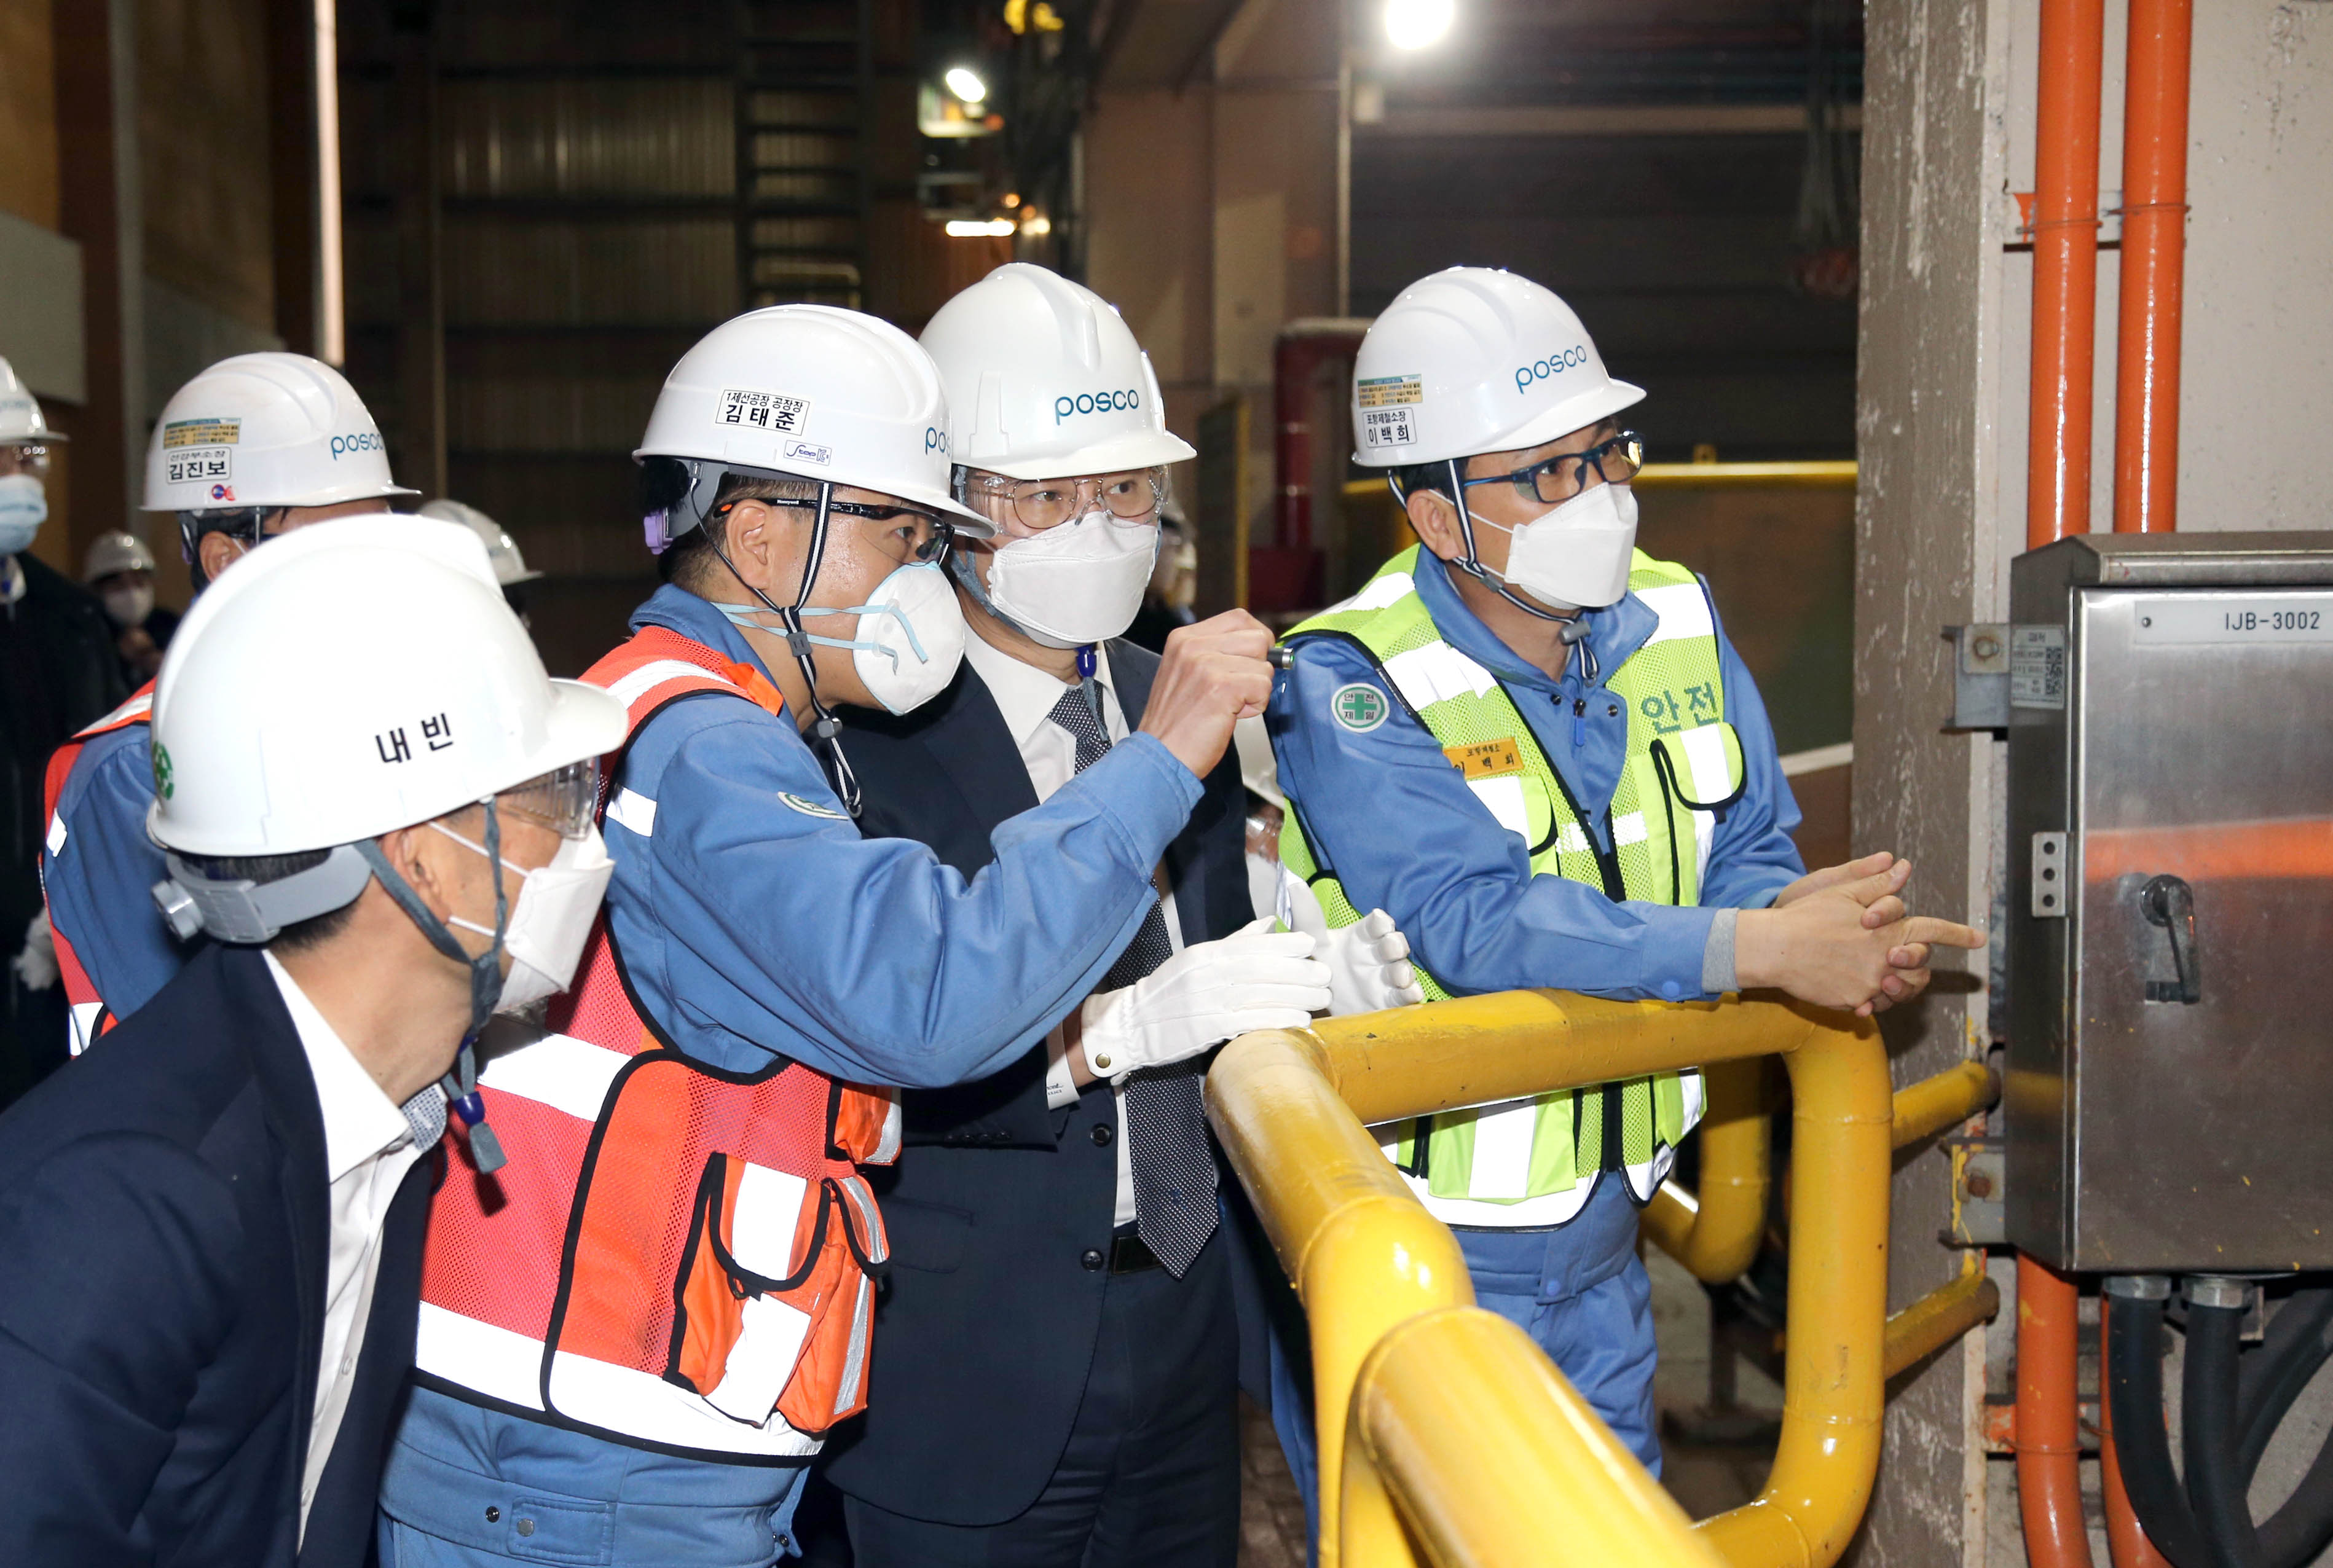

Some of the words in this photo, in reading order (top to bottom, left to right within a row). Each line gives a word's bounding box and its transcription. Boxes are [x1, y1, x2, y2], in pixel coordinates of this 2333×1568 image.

[1516, 345, 1587, 394] posco
[726, 392, 769, 407] 1제선공장
[772, 397, 803, 413] 공장장
[1055, 390, 1139, 426] posco
[1367, 410, 1406, 425] 포항제철소장
[170, 461, 227, 480] 김진보
[2225, 611, 2320, 630] IJB-3002
[1642, 682, 1720, 735] 안전
[376, 712, 454, 763] 내빈
